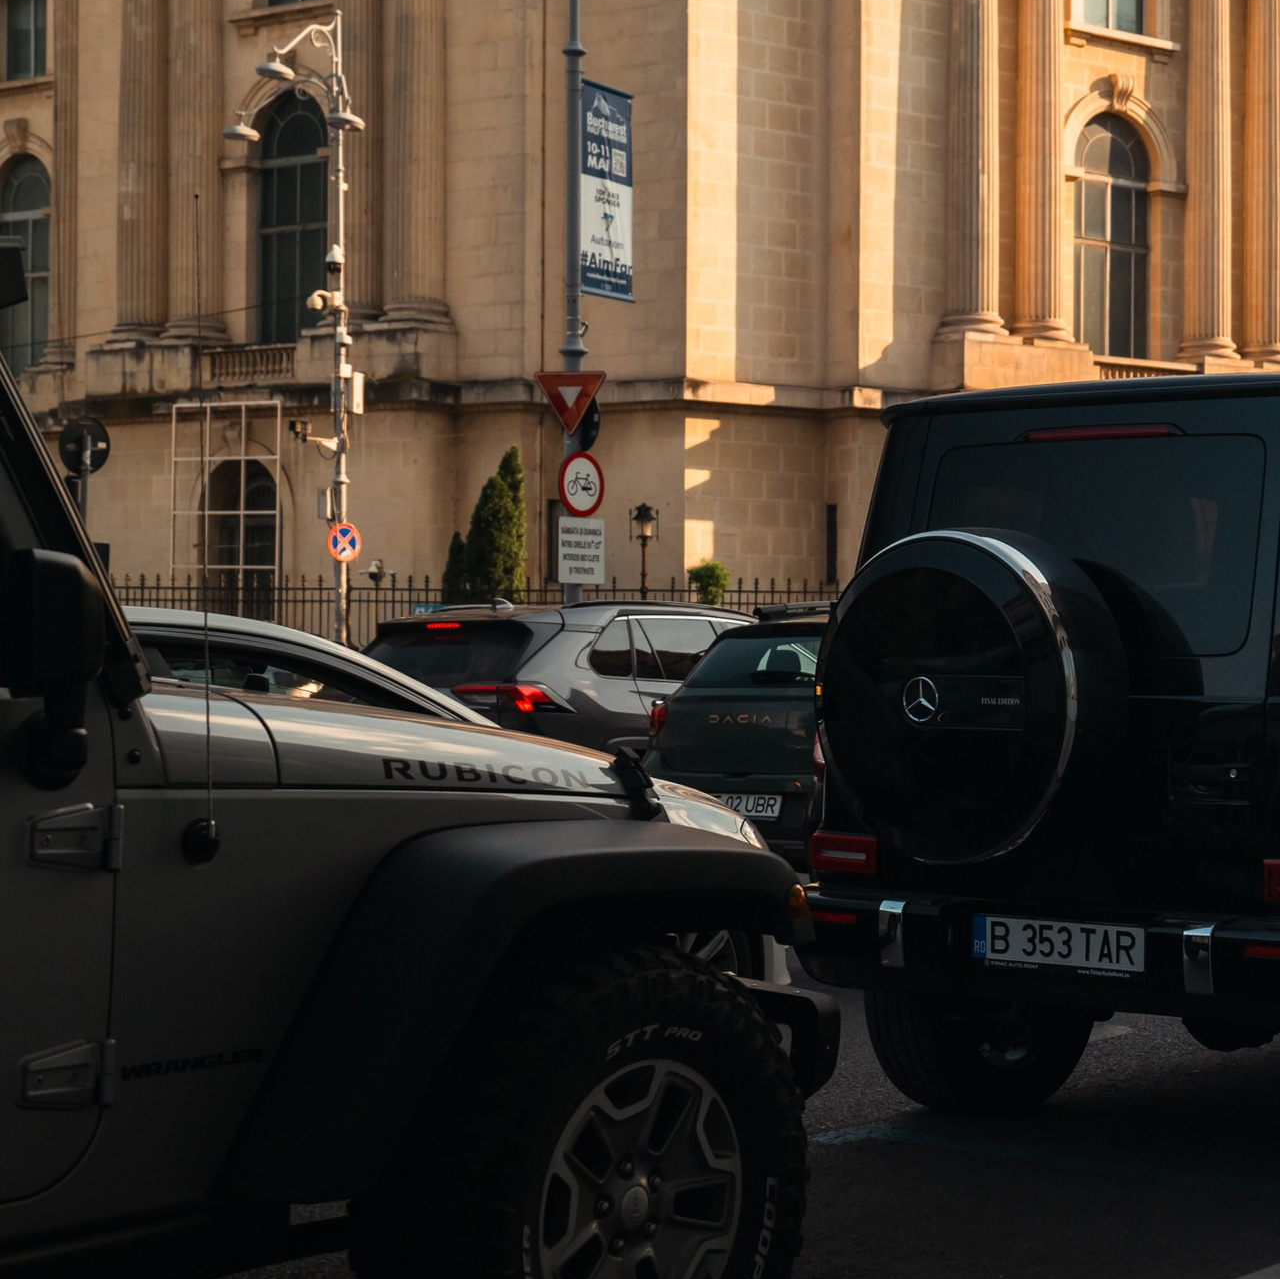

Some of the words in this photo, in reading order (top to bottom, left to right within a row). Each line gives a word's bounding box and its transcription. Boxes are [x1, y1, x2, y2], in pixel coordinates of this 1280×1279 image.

[587, 111, 626, 136] Bucharest
[587, 141, 609, 158] 10-11
[587, 154, 610, 172] MAI
[591, 234, 624, 250] Autonom
[580, 250, 632, 276] #AimFar
[708, 714, 772, 724] DACIA
[382, 757, 591, 789] RUBICON
[745, 796, 778, 814] UBR
[974, 939, 986, 953] RO
[990, 921, 1010, 954] B
[1022, 923, 1072, 959] 353
[1080, 926, 1136, 965] TAR
[605, 1022, 660, 1062] STT
[663, 1026, 704, 1042] PRO
[120, 1048, 263, 1080] WRANGLER
